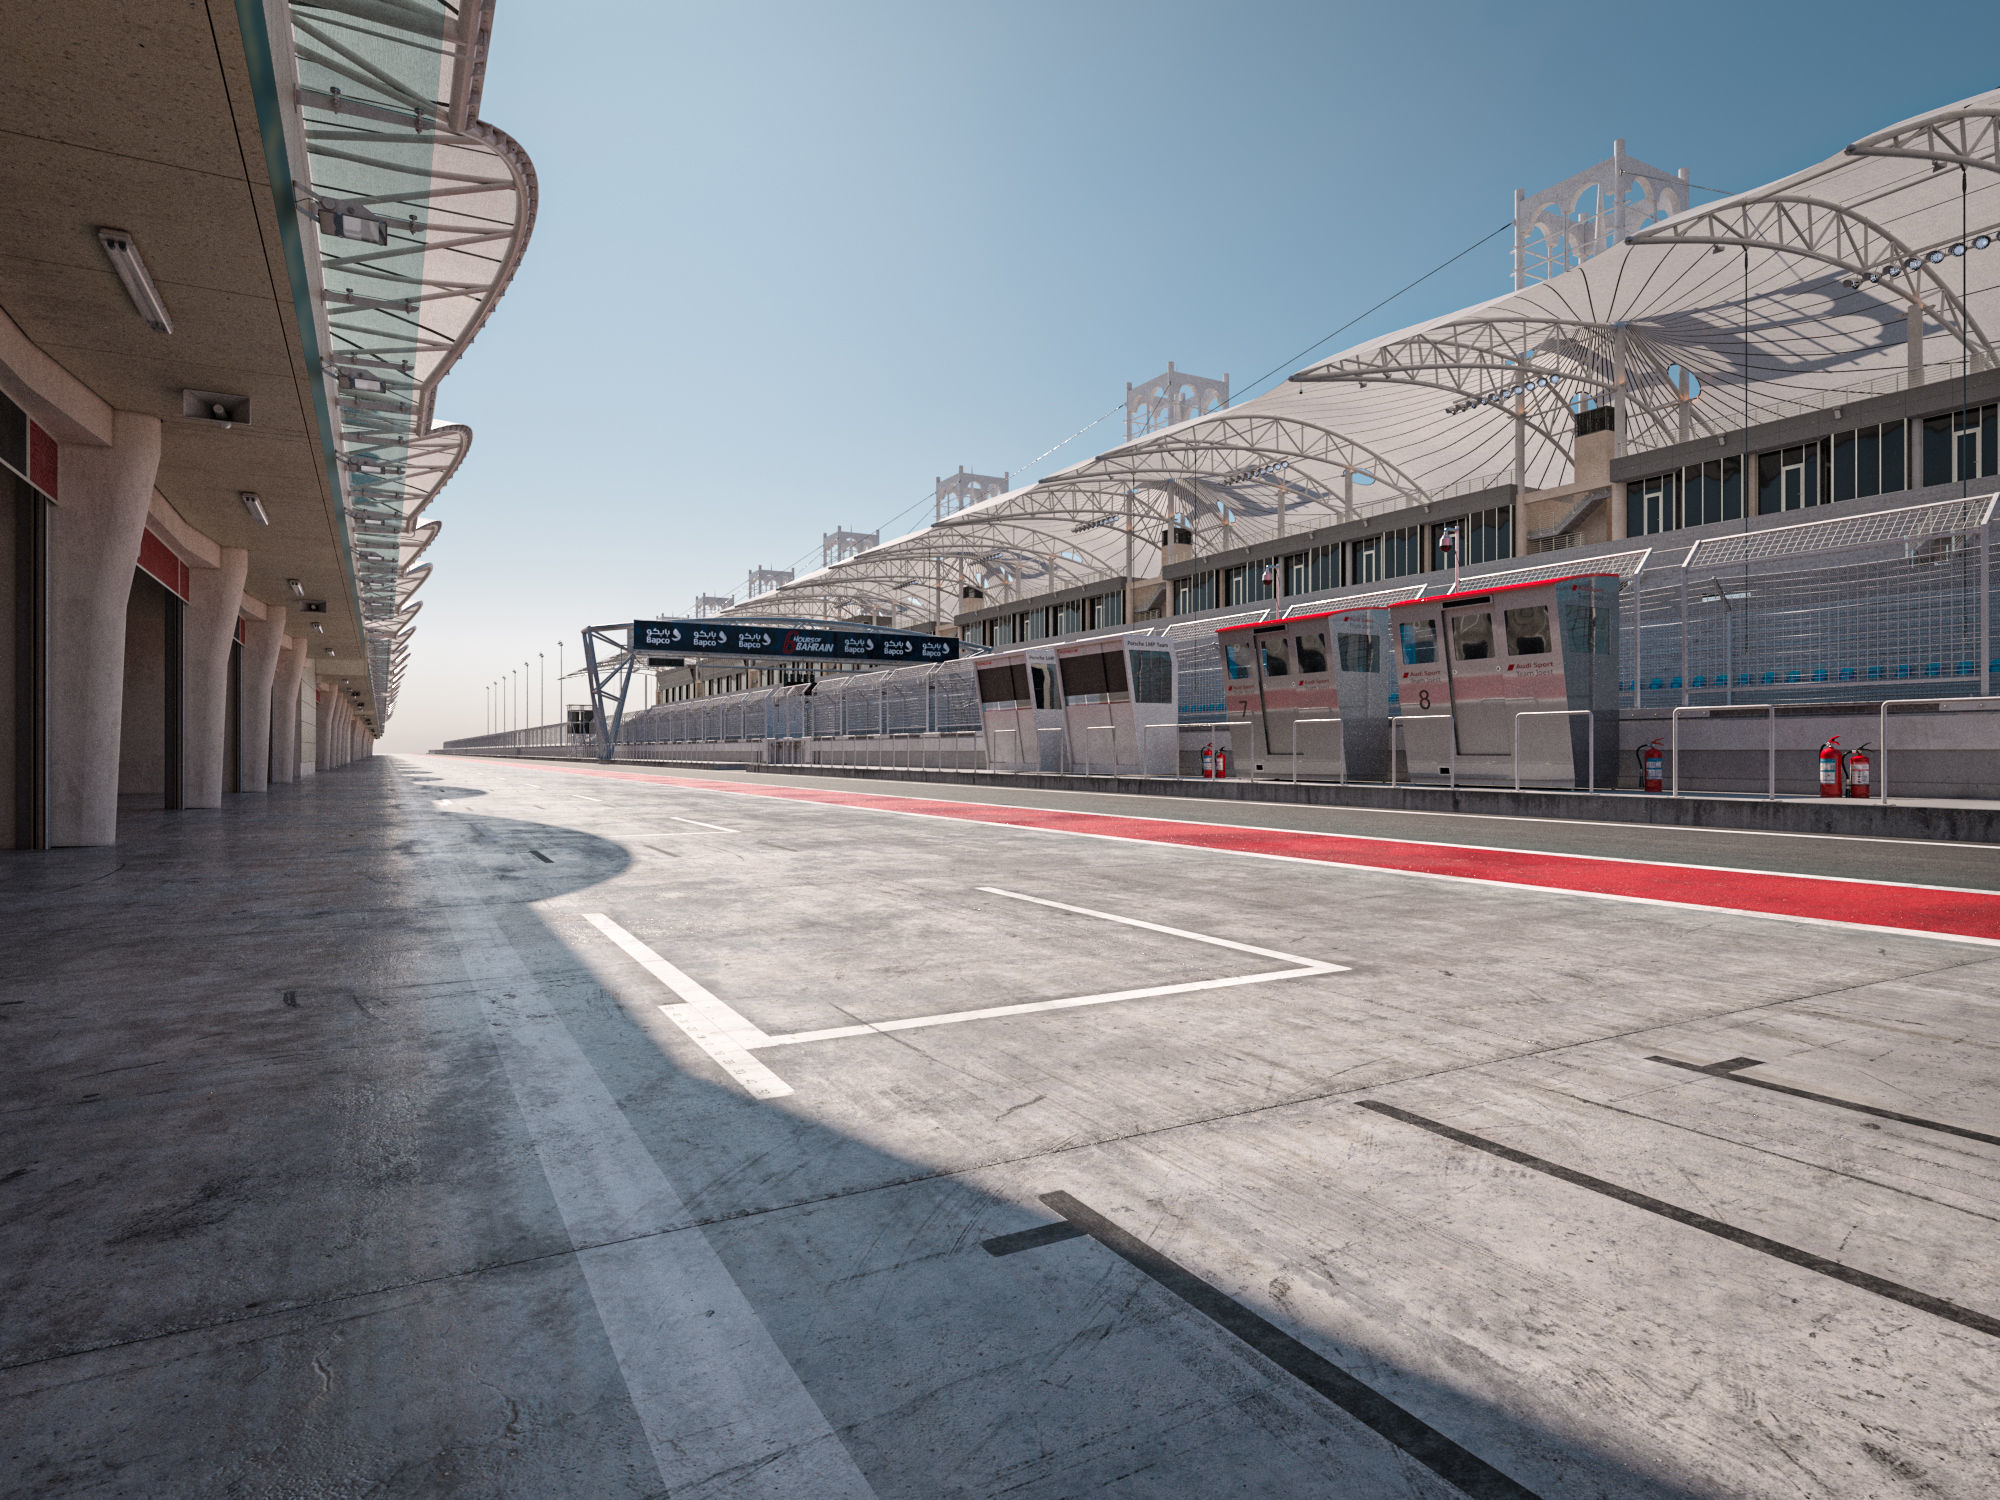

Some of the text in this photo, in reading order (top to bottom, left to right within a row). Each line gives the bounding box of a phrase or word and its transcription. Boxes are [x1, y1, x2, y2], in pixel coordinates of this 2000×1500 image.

[646, 636, 670, 646] Bapco
[693, 638, 717, 648] Bapco
[738, 640, 761, 650] Bapco
[782, 630, 800, 655] 6
[795, 642, 835, 653] BAHRAIN
[844, 645, 865, 654] Bapco
[883, 647, 904, 657] Bapco
[922, 649, 941, 658] Bapco
[1516, 661, 1553, 670] Audi Sport
[1419, 689, 1431, 710] 8
[1239, 700, 1248, 718] 7
